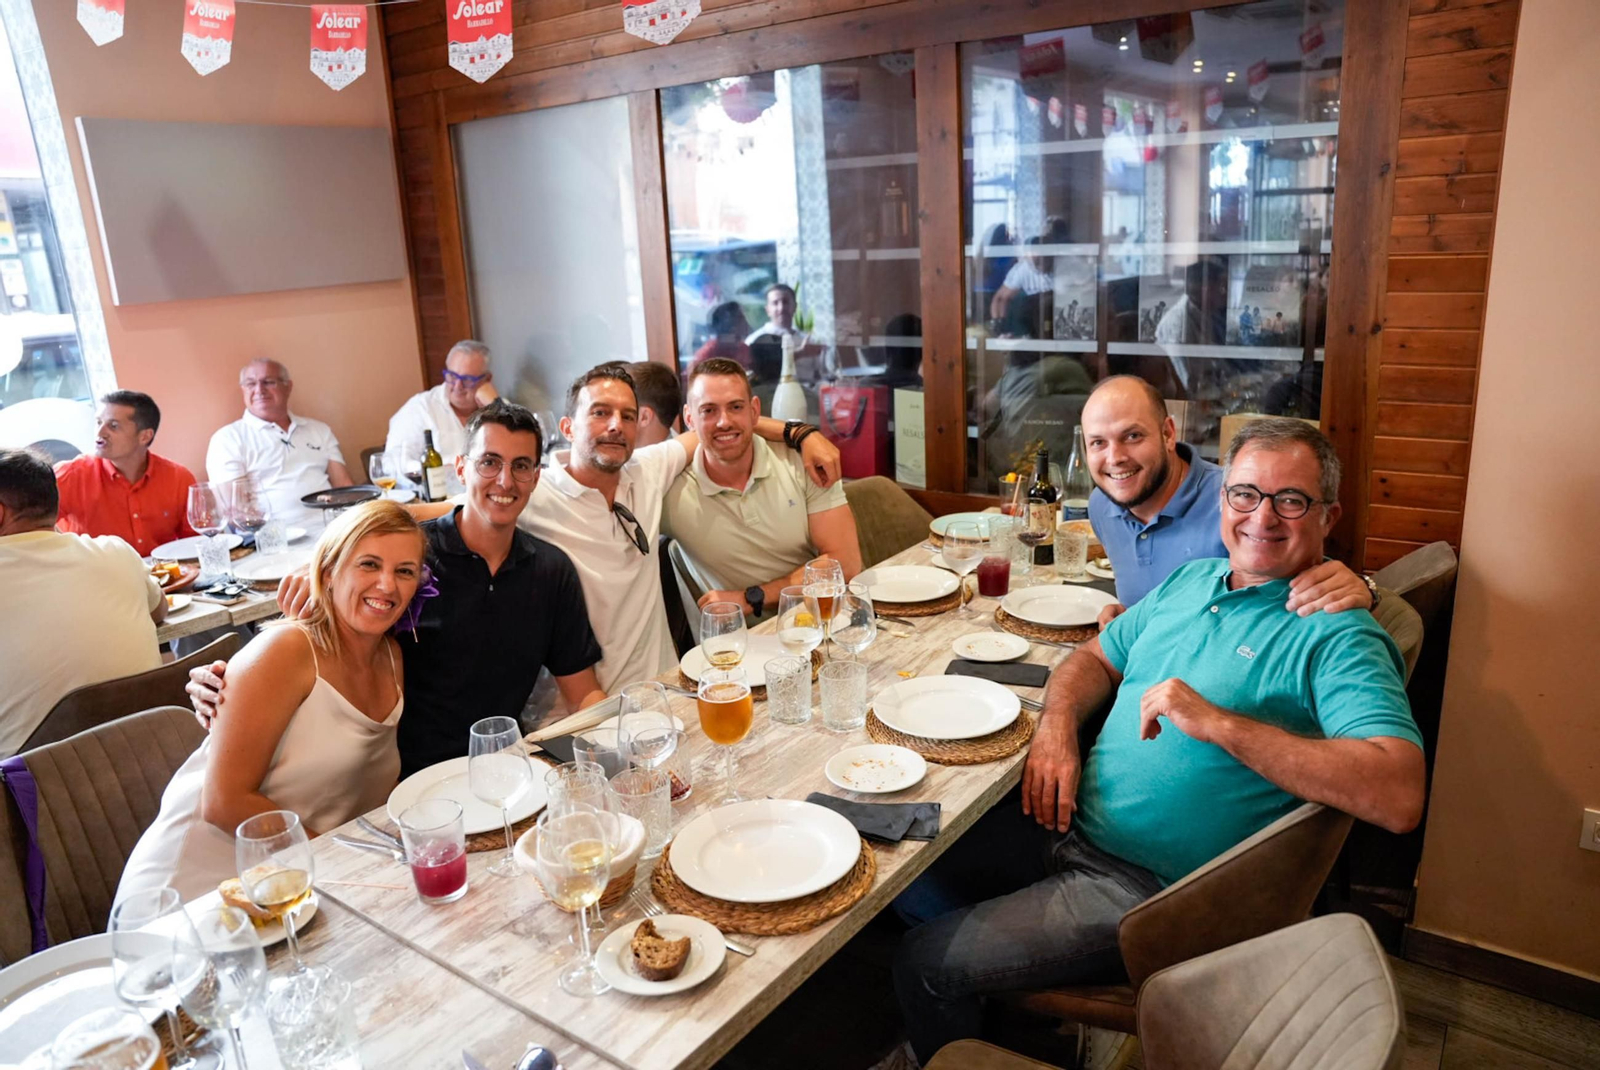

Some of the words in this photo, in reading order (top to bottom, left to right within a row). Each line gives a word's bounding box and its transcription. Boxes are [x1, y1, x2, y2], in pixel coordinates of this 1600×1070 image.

[189, 0, 230, 21] Solear
[316, 11, 361, 29] Solear
[453, 0, 504, 20] Solear
